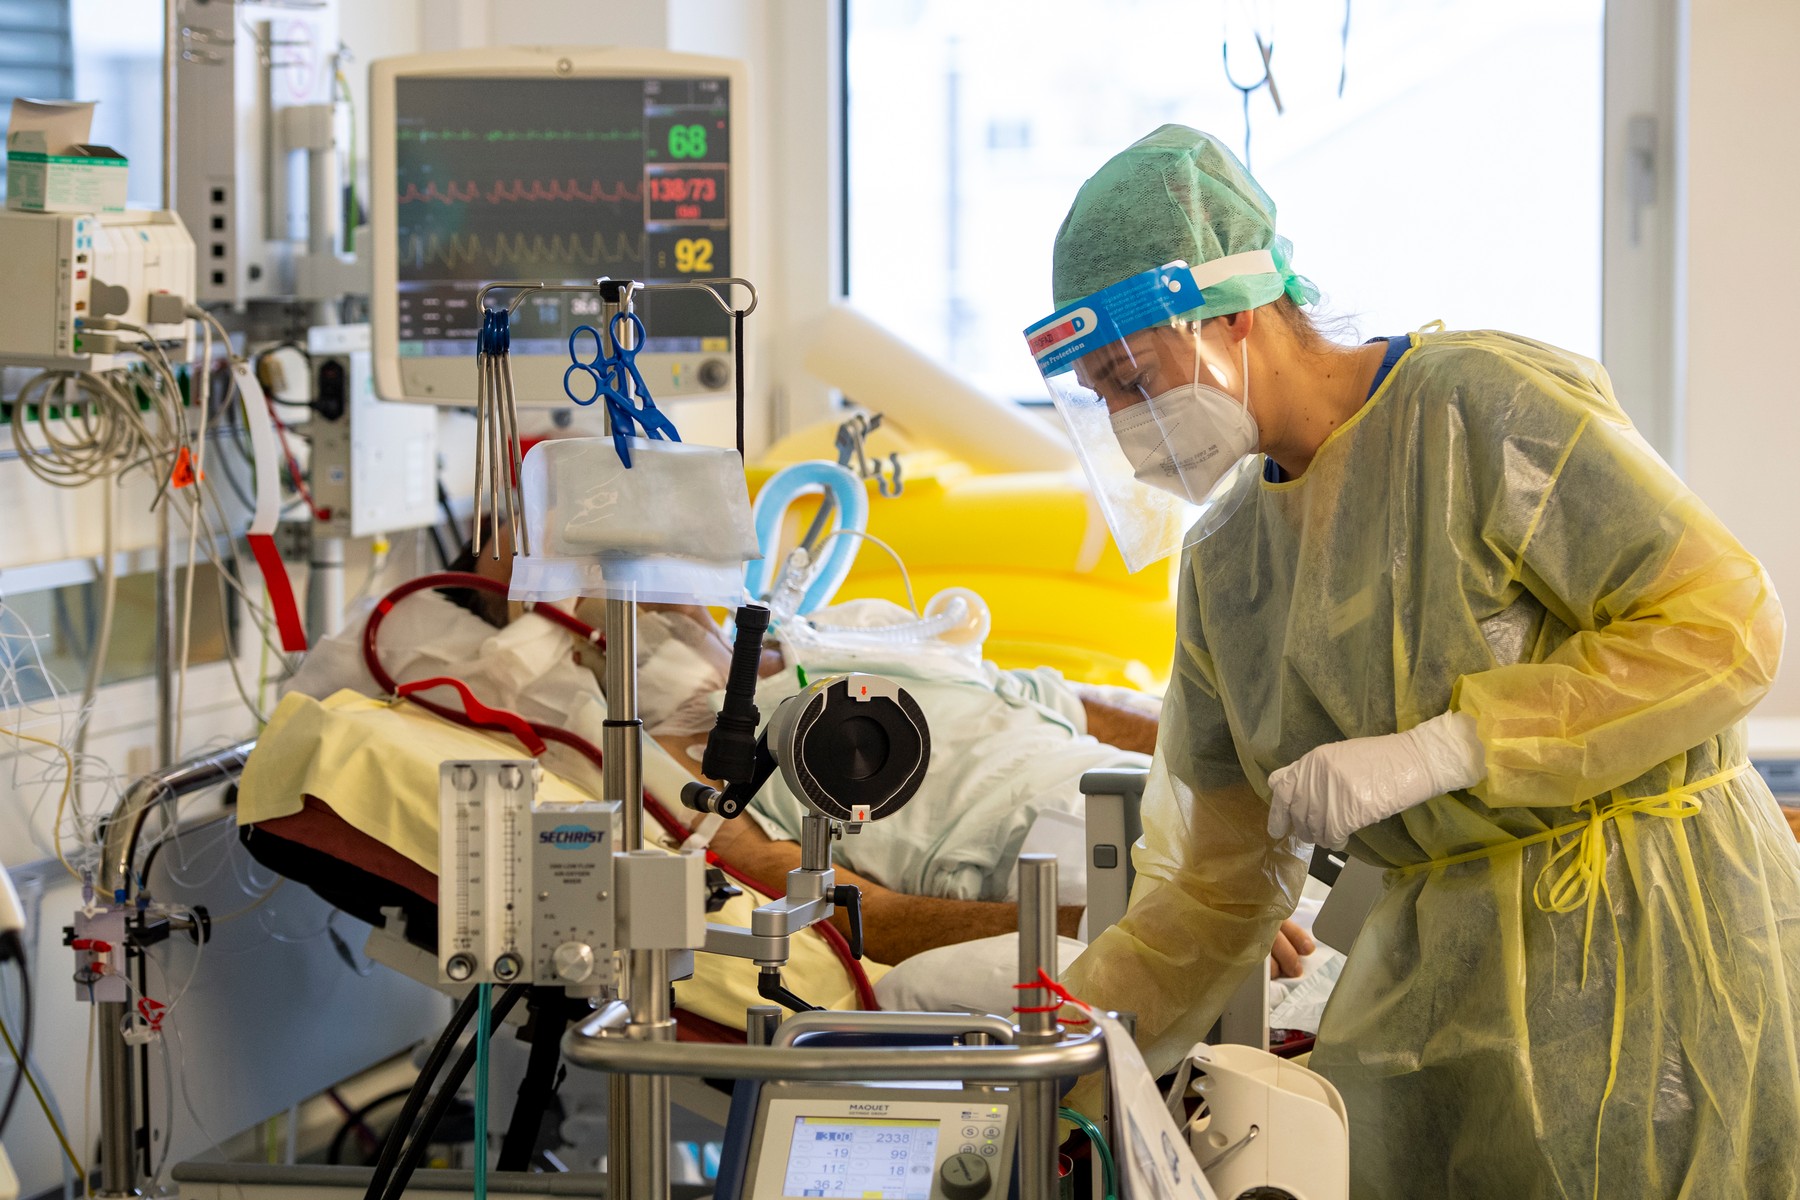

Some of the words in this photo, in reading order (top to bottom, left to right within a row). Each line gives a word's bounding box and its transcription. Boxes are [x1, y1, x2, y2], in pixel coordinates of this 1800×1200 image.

[668, 124, 708, 159] 68
[675, 238, 714, 272] 92
[1048, 342, 1085, 364] Protection
[539, 831, 606, 844] SECHRIST
[876, 1133, 910, 1144] 2338
[890, 1150, 908, 1160] 99
[822, 1164, 846, 1174] 115
[889, 1166, 905, 1176] 18
